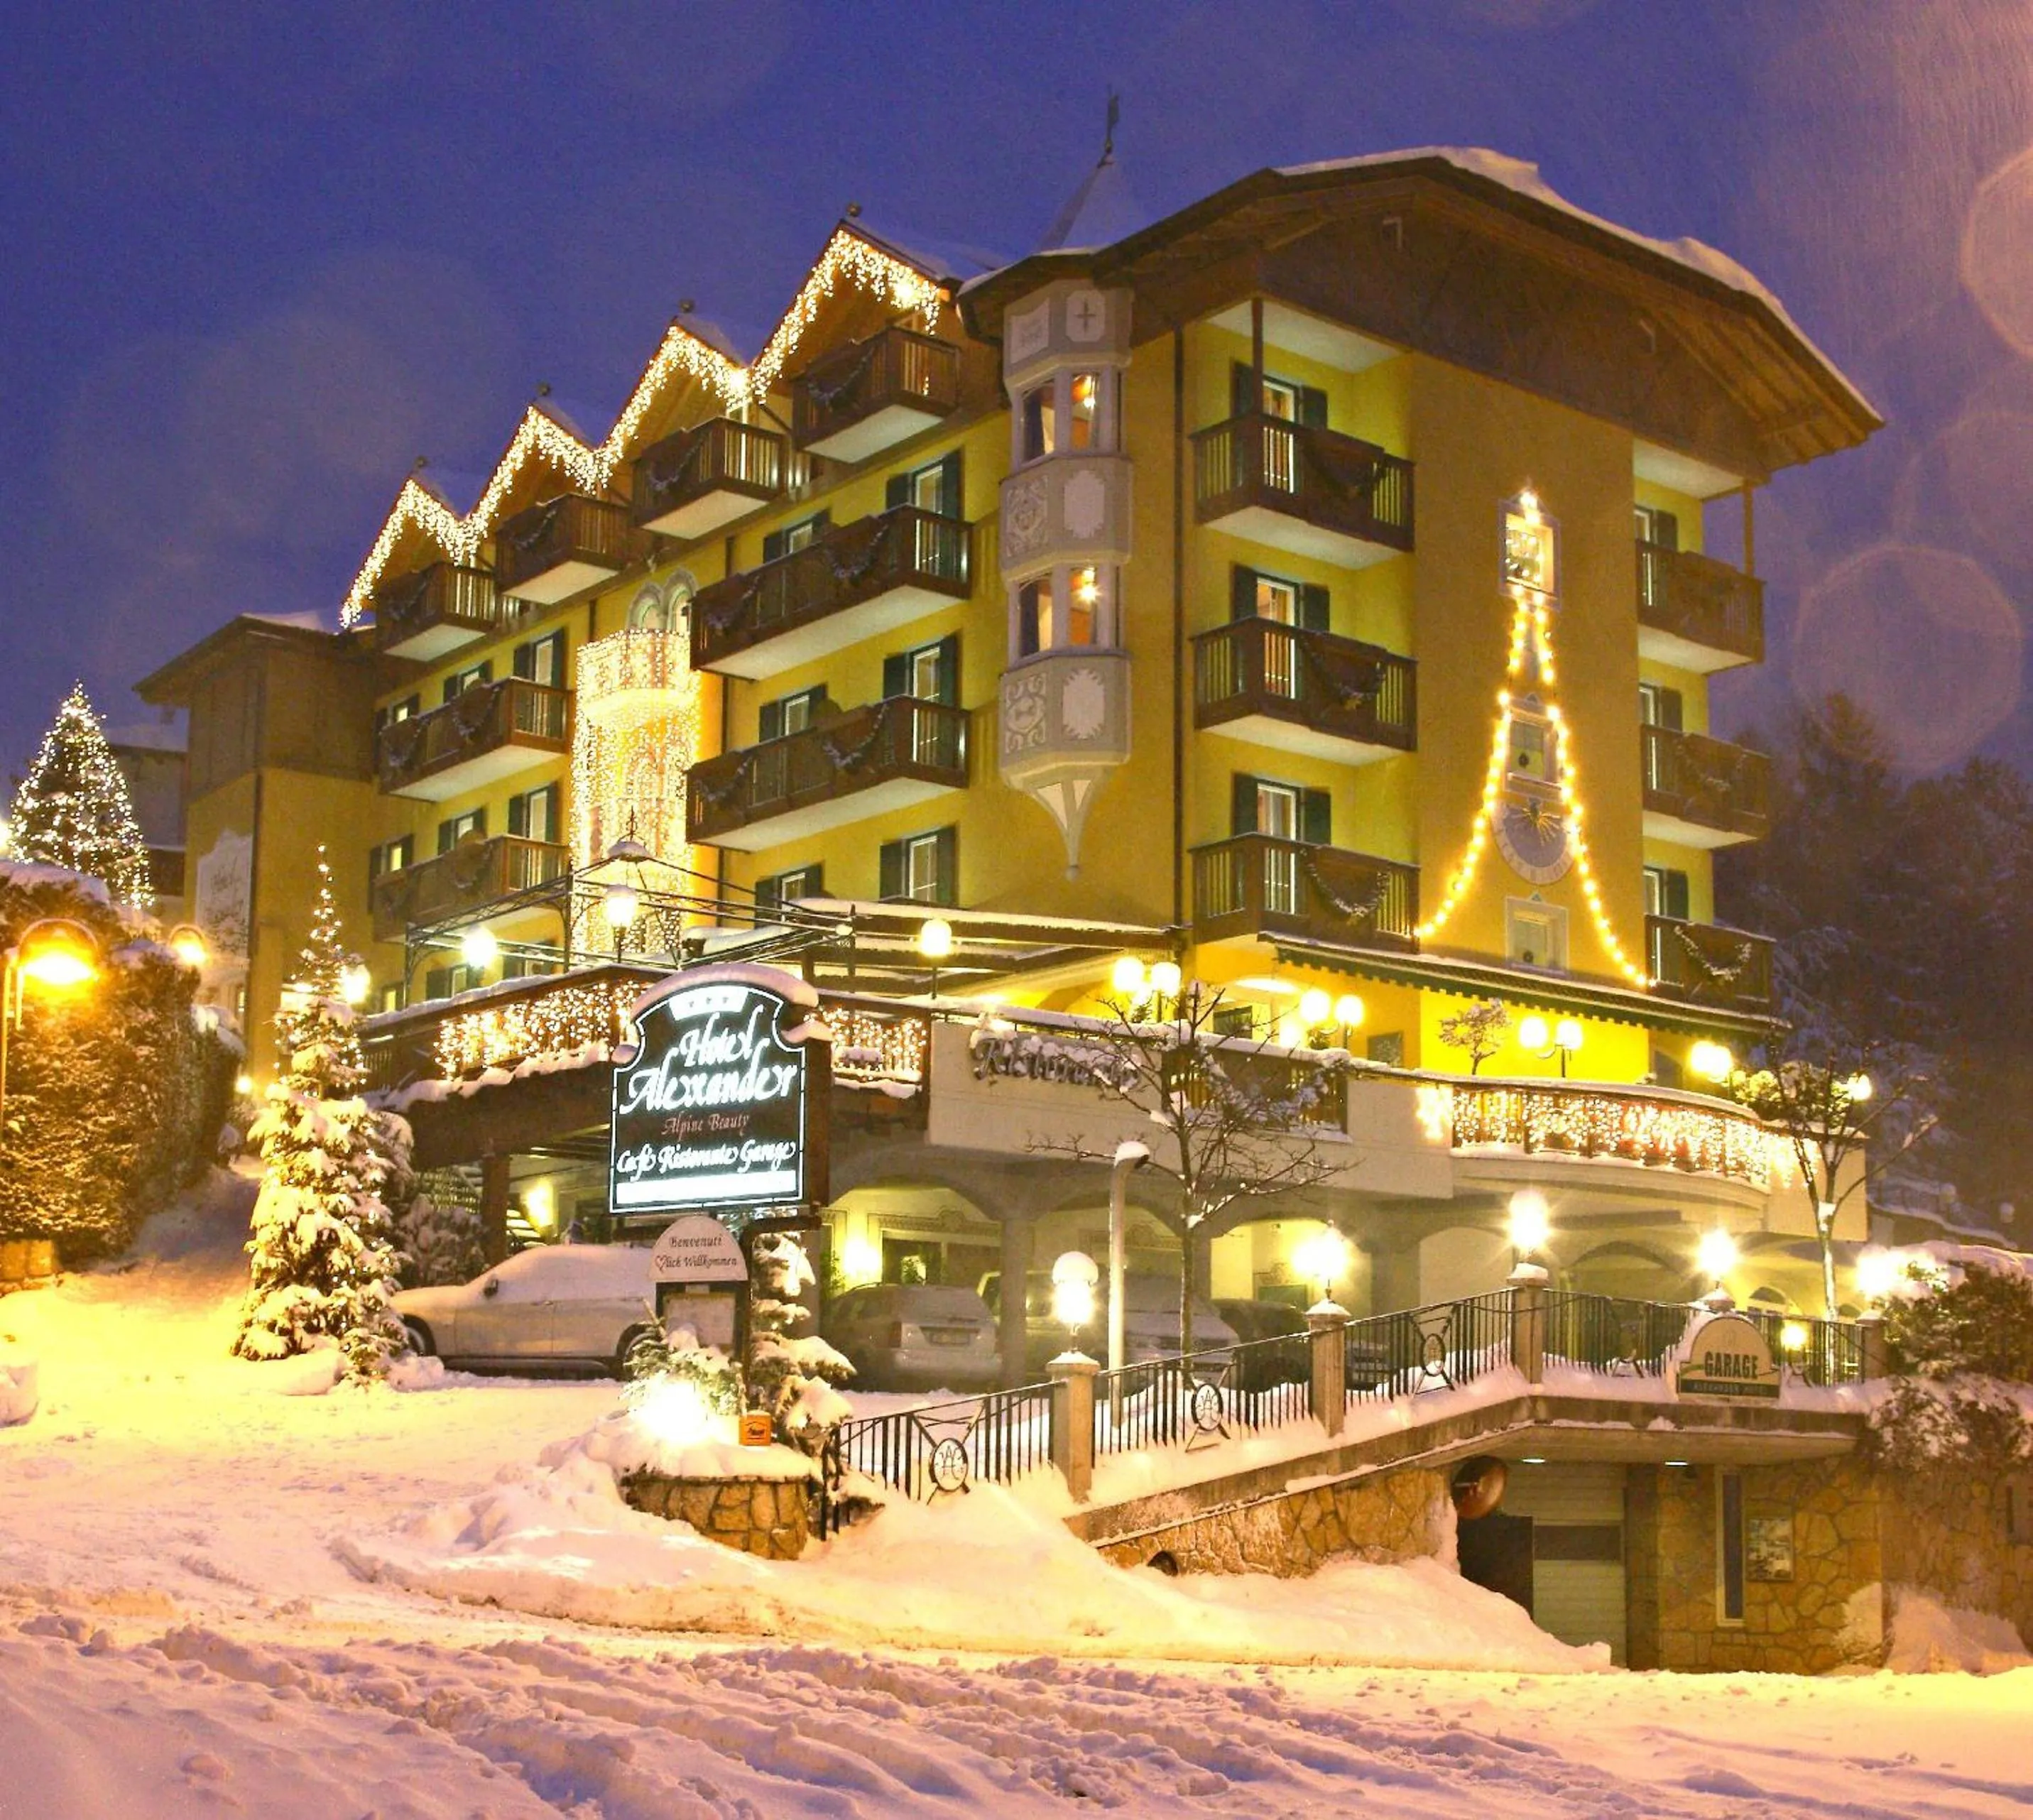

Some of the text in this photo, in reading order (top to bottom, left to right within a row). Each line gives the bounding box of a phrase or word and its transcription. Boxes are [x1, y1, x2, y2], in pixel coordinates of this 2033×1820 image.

[680, 1004, 764, 1067] Hotel
[619, 1038, 797, 1114] Alexander
[660, 1111, 750, 1142] Alpine Beauty
[669, 1234, 723, 1248] Benvenuti
[685, 1255, 738, 1269] Willkommen
[1705, 1351, 1759, 1379] GARAGE
